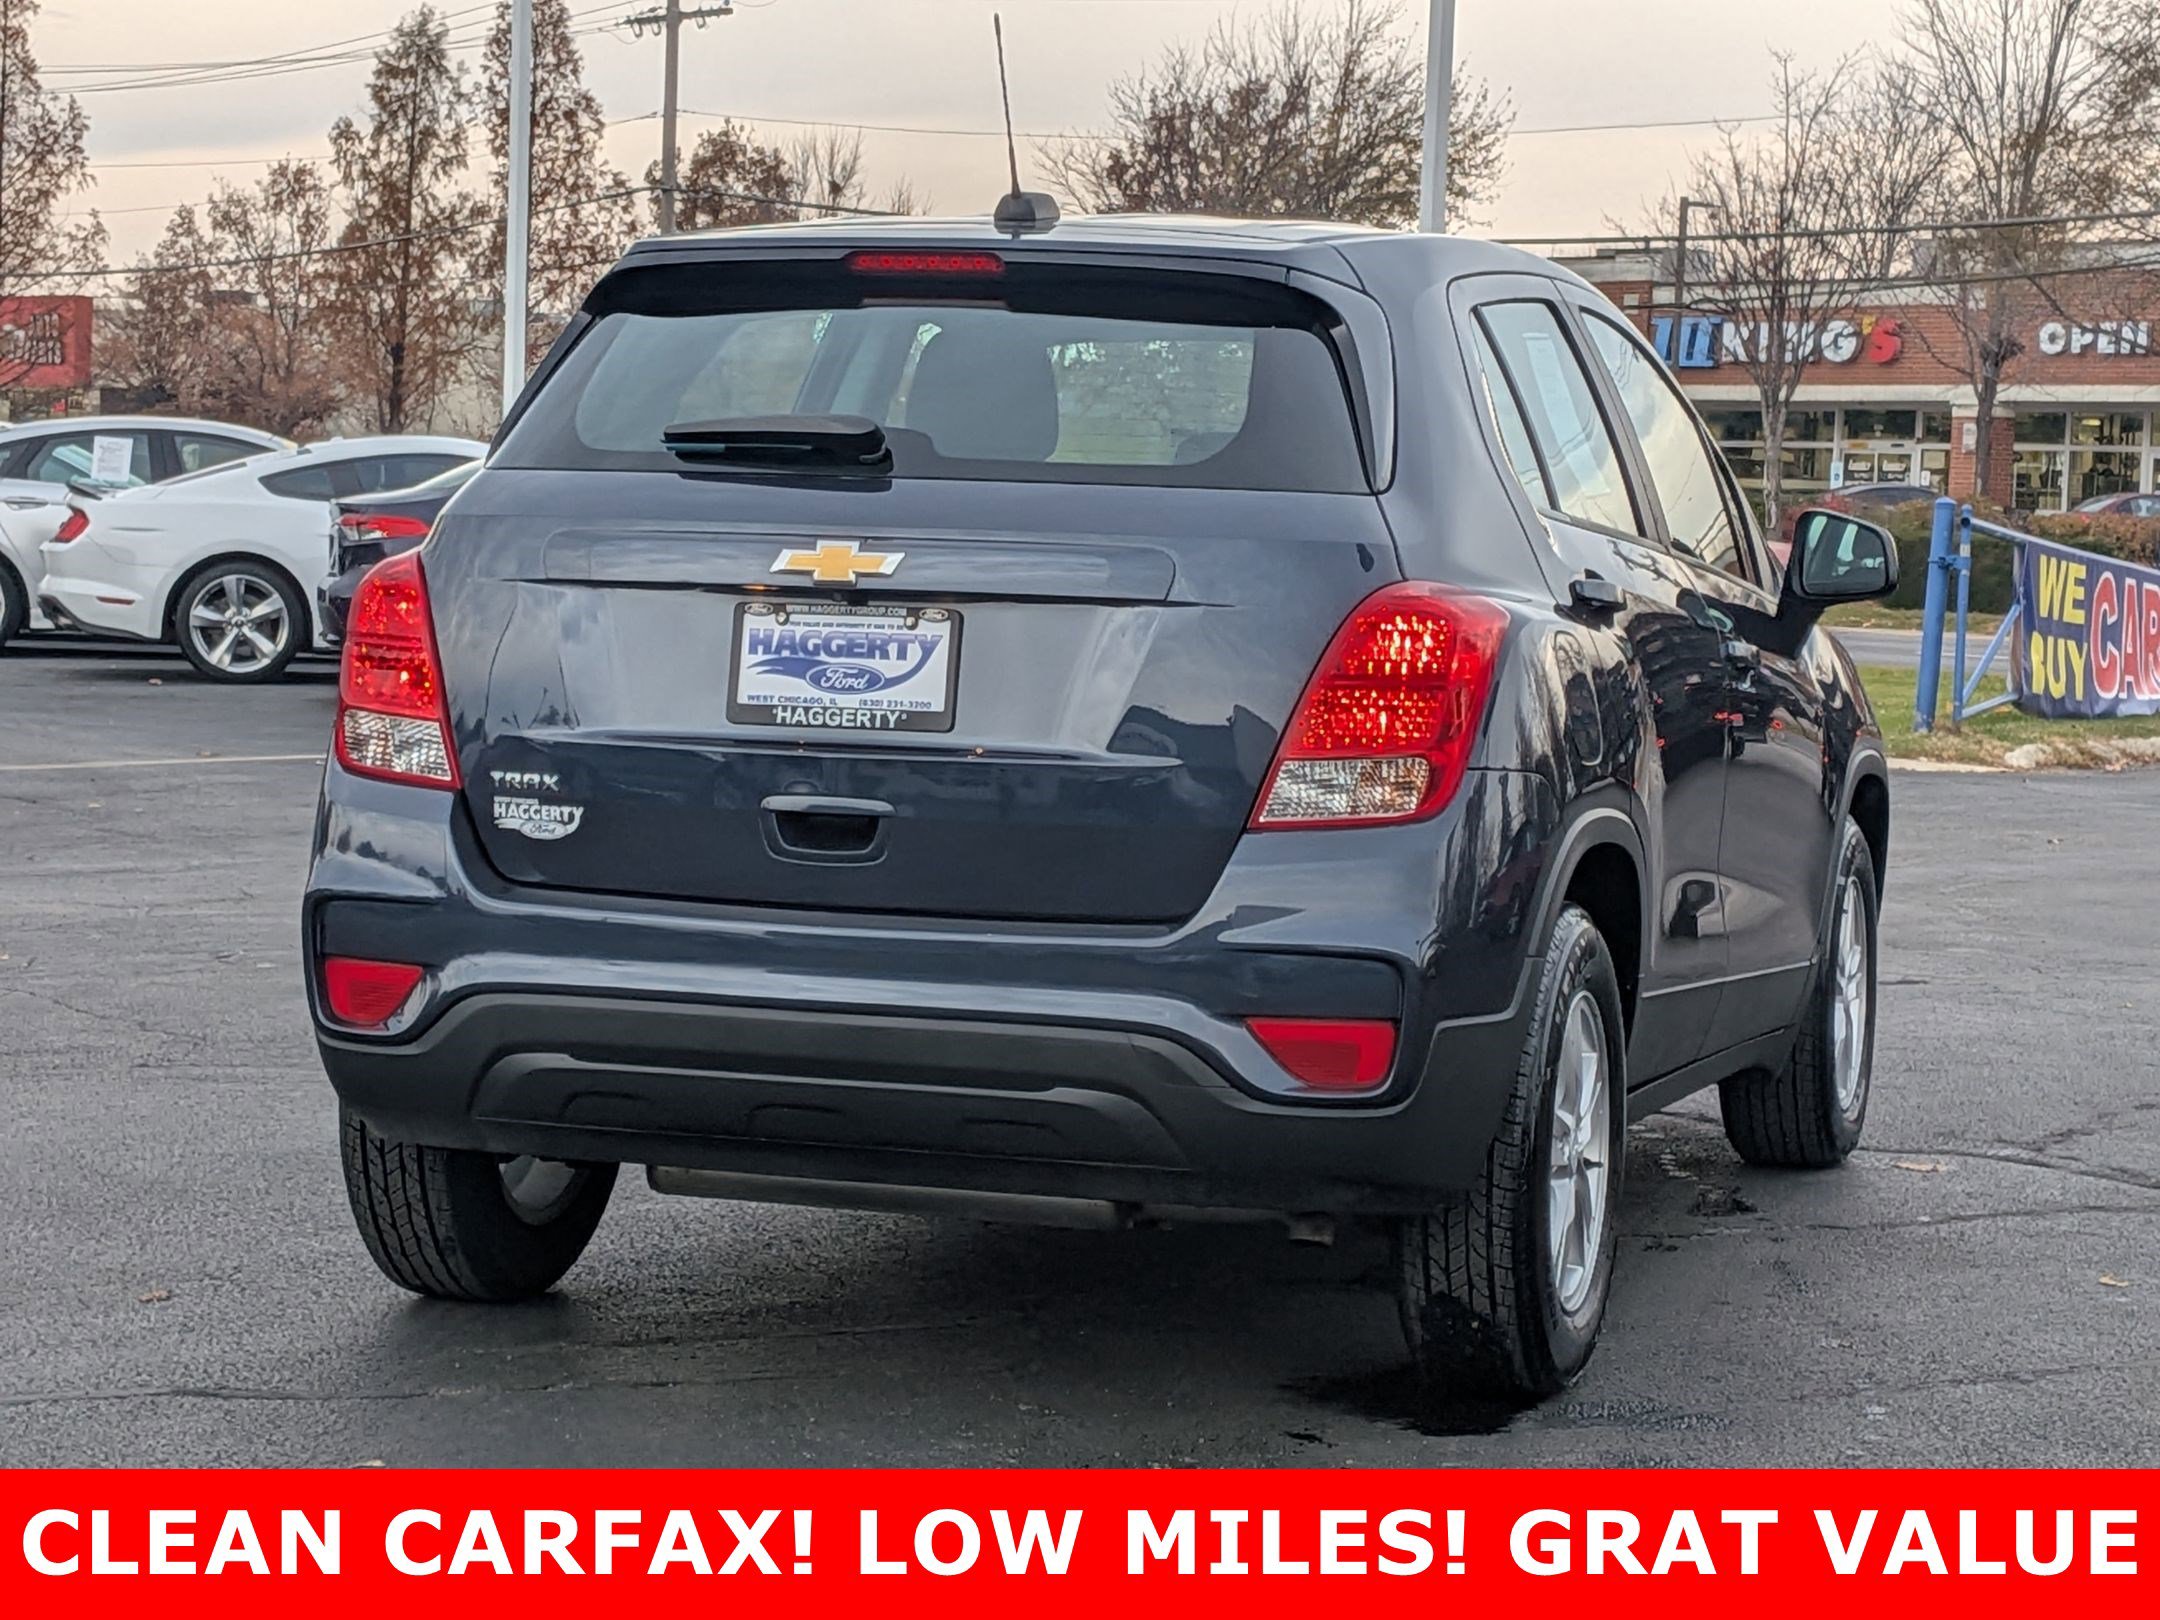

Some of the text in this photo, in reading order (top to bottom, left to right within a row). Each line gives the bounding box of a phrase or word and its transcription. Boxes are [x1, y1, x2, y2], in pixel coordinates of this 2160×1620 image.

[2039, 321, 2148, 355] OPEN
[2039, 554, 2087, 624] WE
[747, 628, 943, 661] HAGGERTY
[2089, 570, 2160, 700] CAR
[820, 667, 868, 690] Ford
[2030, 631, 2088, 701] BUY
[747, 694, 775, 704] WEST
[775, 706, 900, 729] HAGGERTY
[490, 770, 560, 792] TRAX
[493, 801, 584, 823] HAGGERTY
